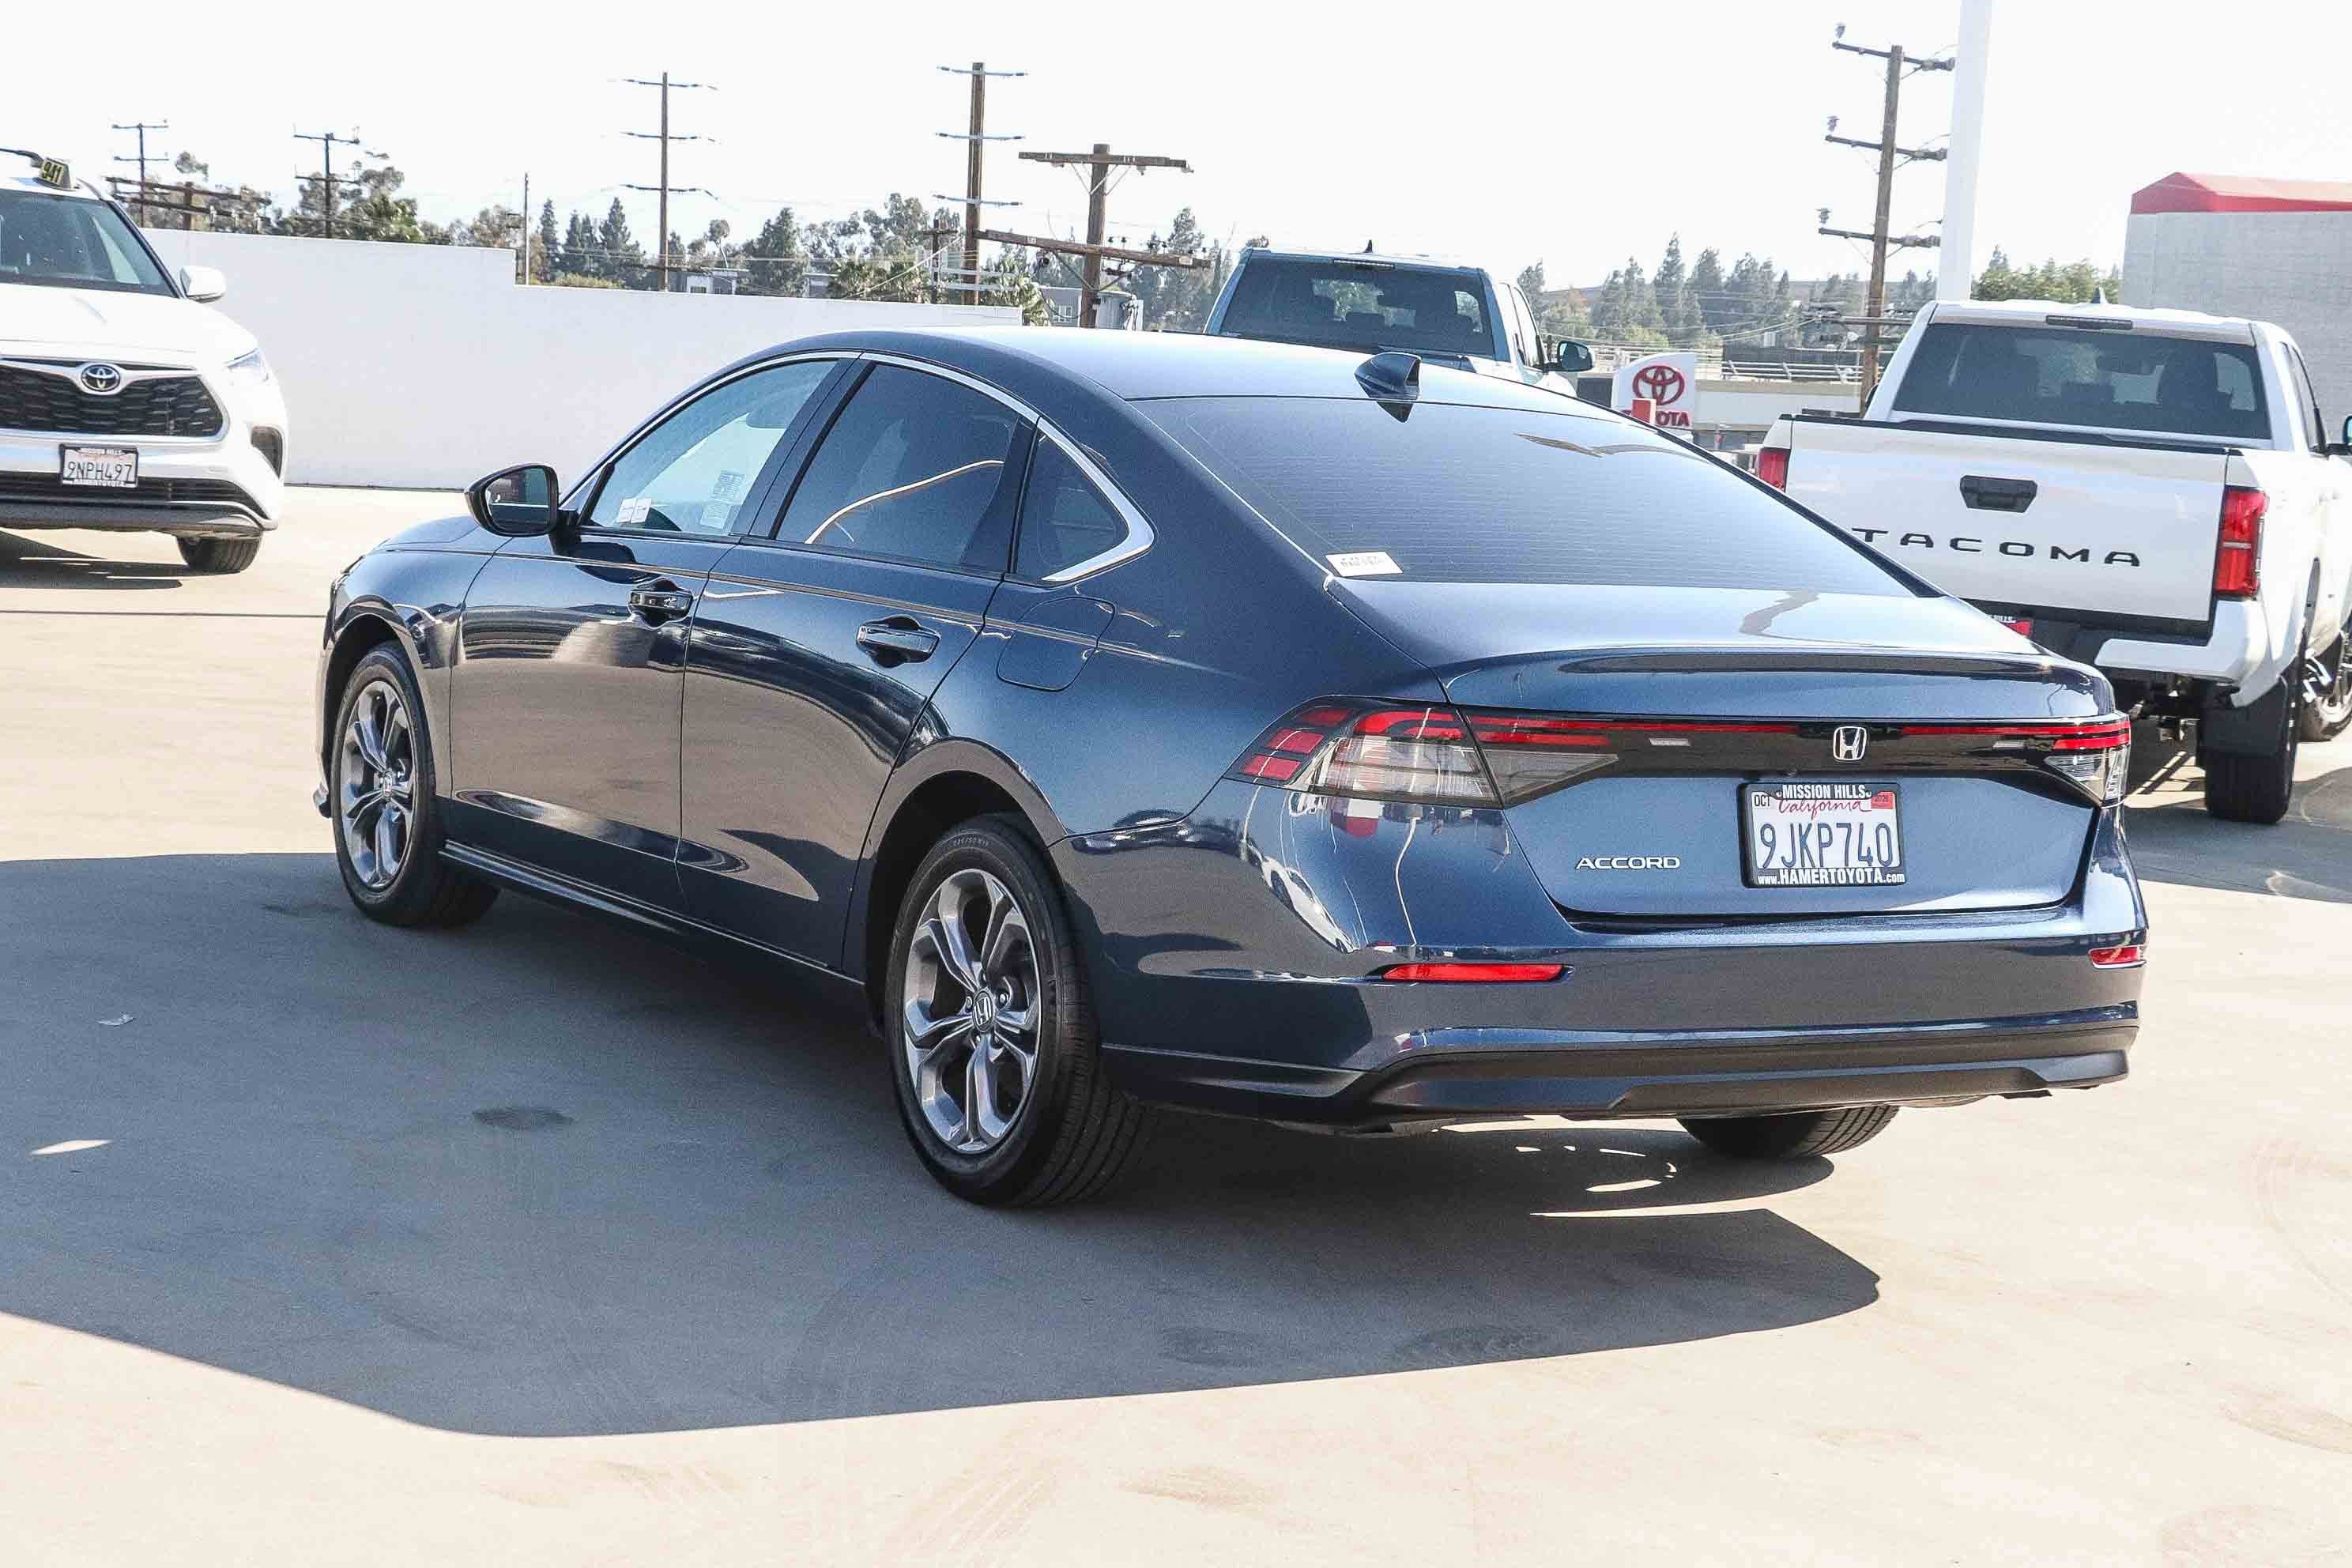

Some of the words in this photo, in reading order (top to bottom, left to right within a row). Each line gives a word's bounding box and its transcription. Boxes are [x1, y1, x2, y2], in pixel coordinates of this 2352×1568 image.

[67, 461, 133, 481] 9NPH497
[1852, 526, 2141, 567] TACOMA
[1781, 784, 1832, 800] MISSION
[1834, 784, 1866, 799] HILLS
[1778, 799, 1872, 820] California
[1759, 822, 1894, 869] 9JKP740
[1576, 857, 1680, 869] ACCORD
[1757, 868, 1905, 886] www.HAMERTOYOTA.com
